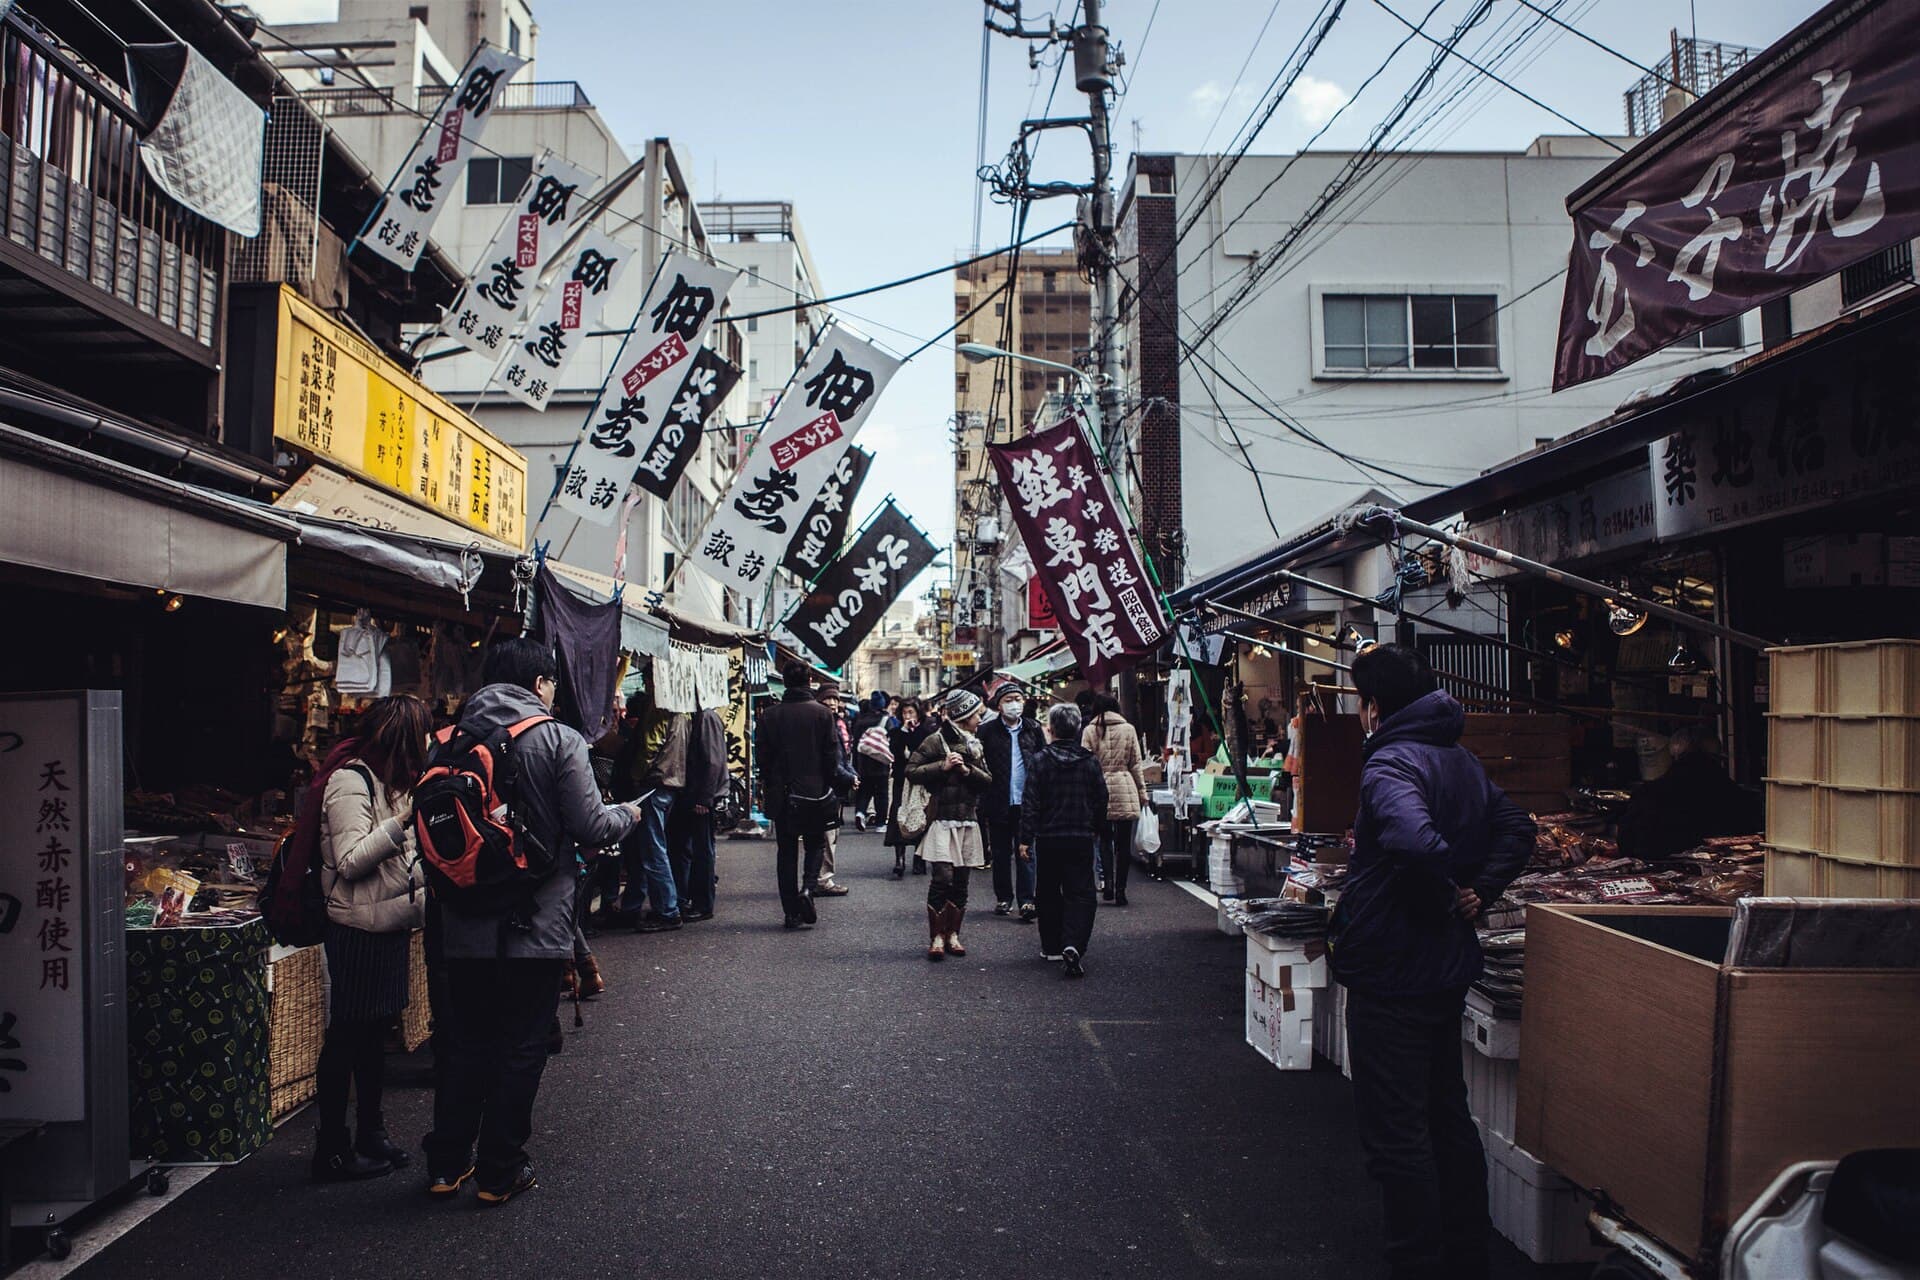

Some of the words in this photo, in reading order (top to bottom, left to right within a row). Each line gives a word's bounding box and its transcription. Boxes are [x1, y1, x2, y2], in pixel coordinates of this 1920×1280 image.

[308, 336, 324, 448] 惣菜問屋
[626, 339, 684, 393] 江戸前
[778, 416, 840, 465] 江戸前
[565, 465, 618, 509] 諏訪
[704, 529, 765, 581] 諏訪
[36, 760, 72, 991] 天然赤酢使用
[1632, 1243, 1663, 1268] HONDA
